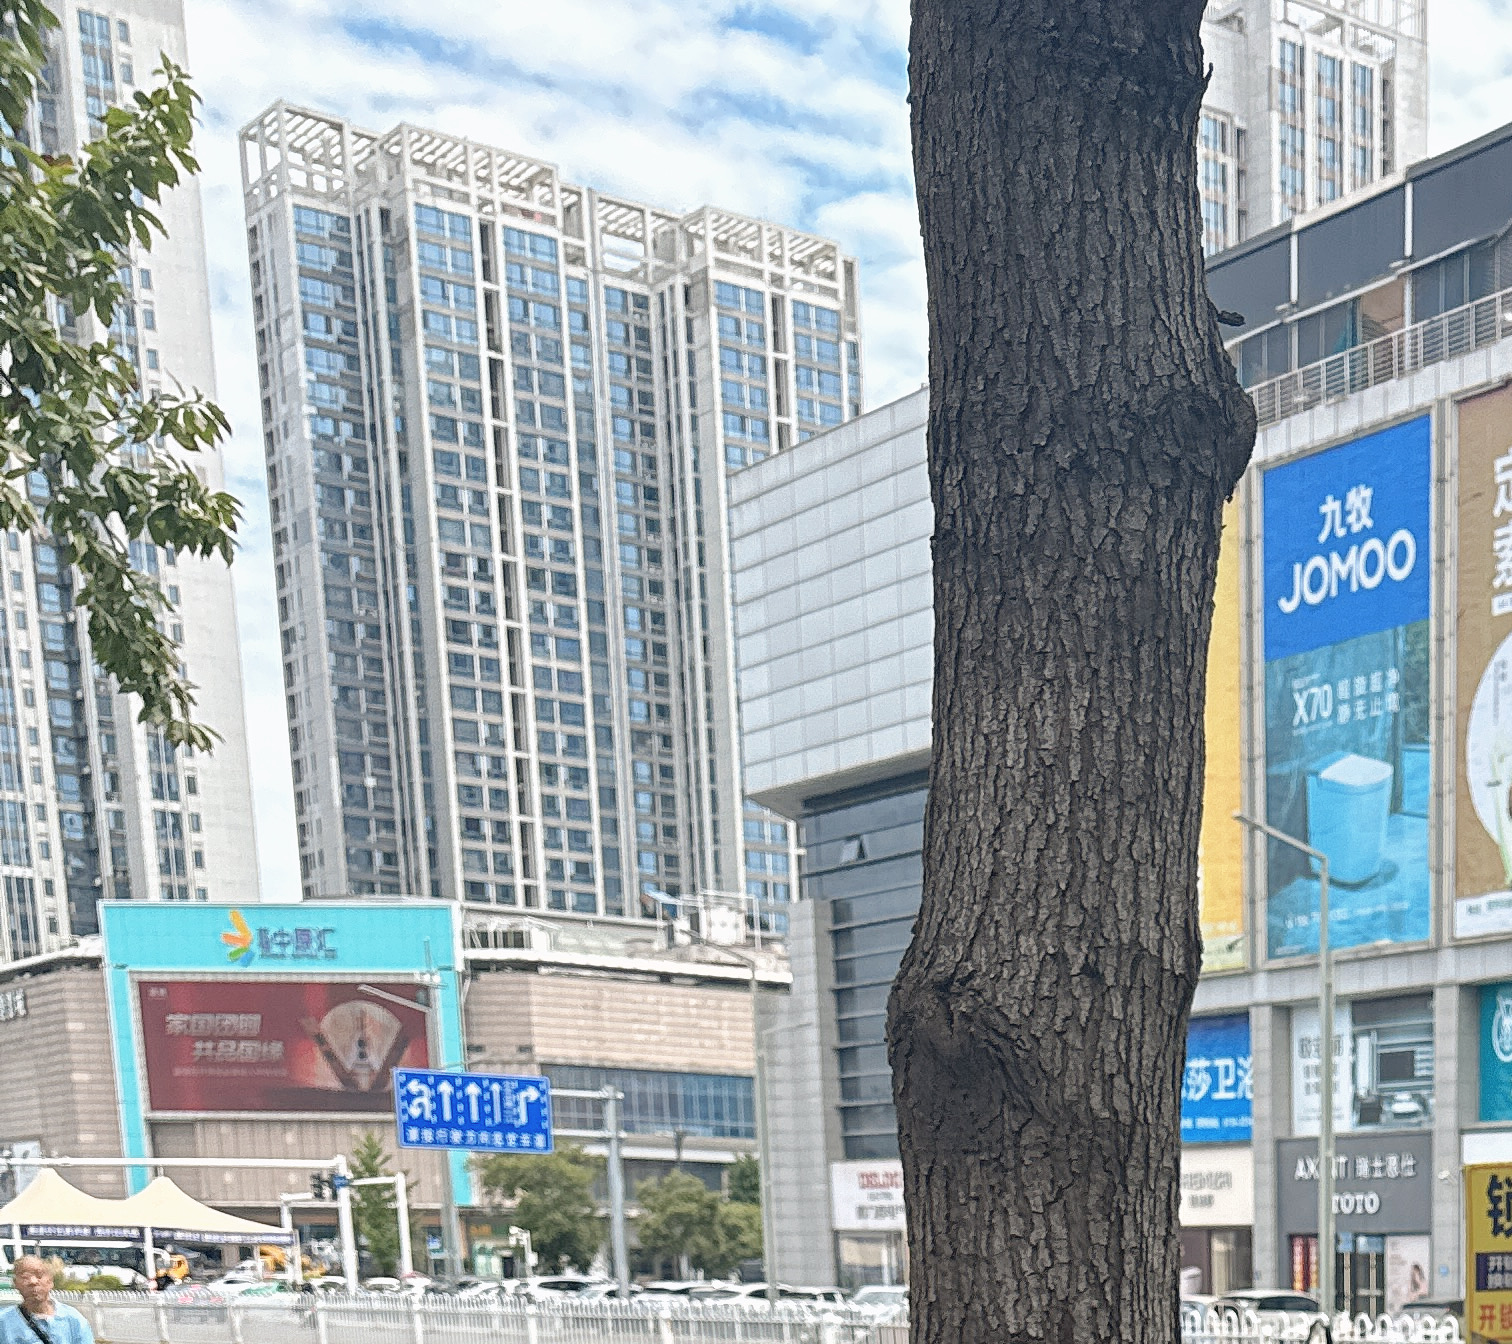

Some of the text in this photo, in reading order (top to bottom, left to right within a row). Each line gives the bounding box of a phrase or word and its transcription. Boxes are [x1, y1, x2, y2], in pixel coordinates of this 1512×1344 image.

[1318, 483, 1375, 544] 九牧
[1277, 528, 1417, 614] JOMOO
[1292, 683, 1333, 726] X70
[1182, 1057, 1254, 1101] 莎卫浴
[1294, 1155, 1349, 1180] AXT
[1331, 1191, 1381, 1215] TOTO
